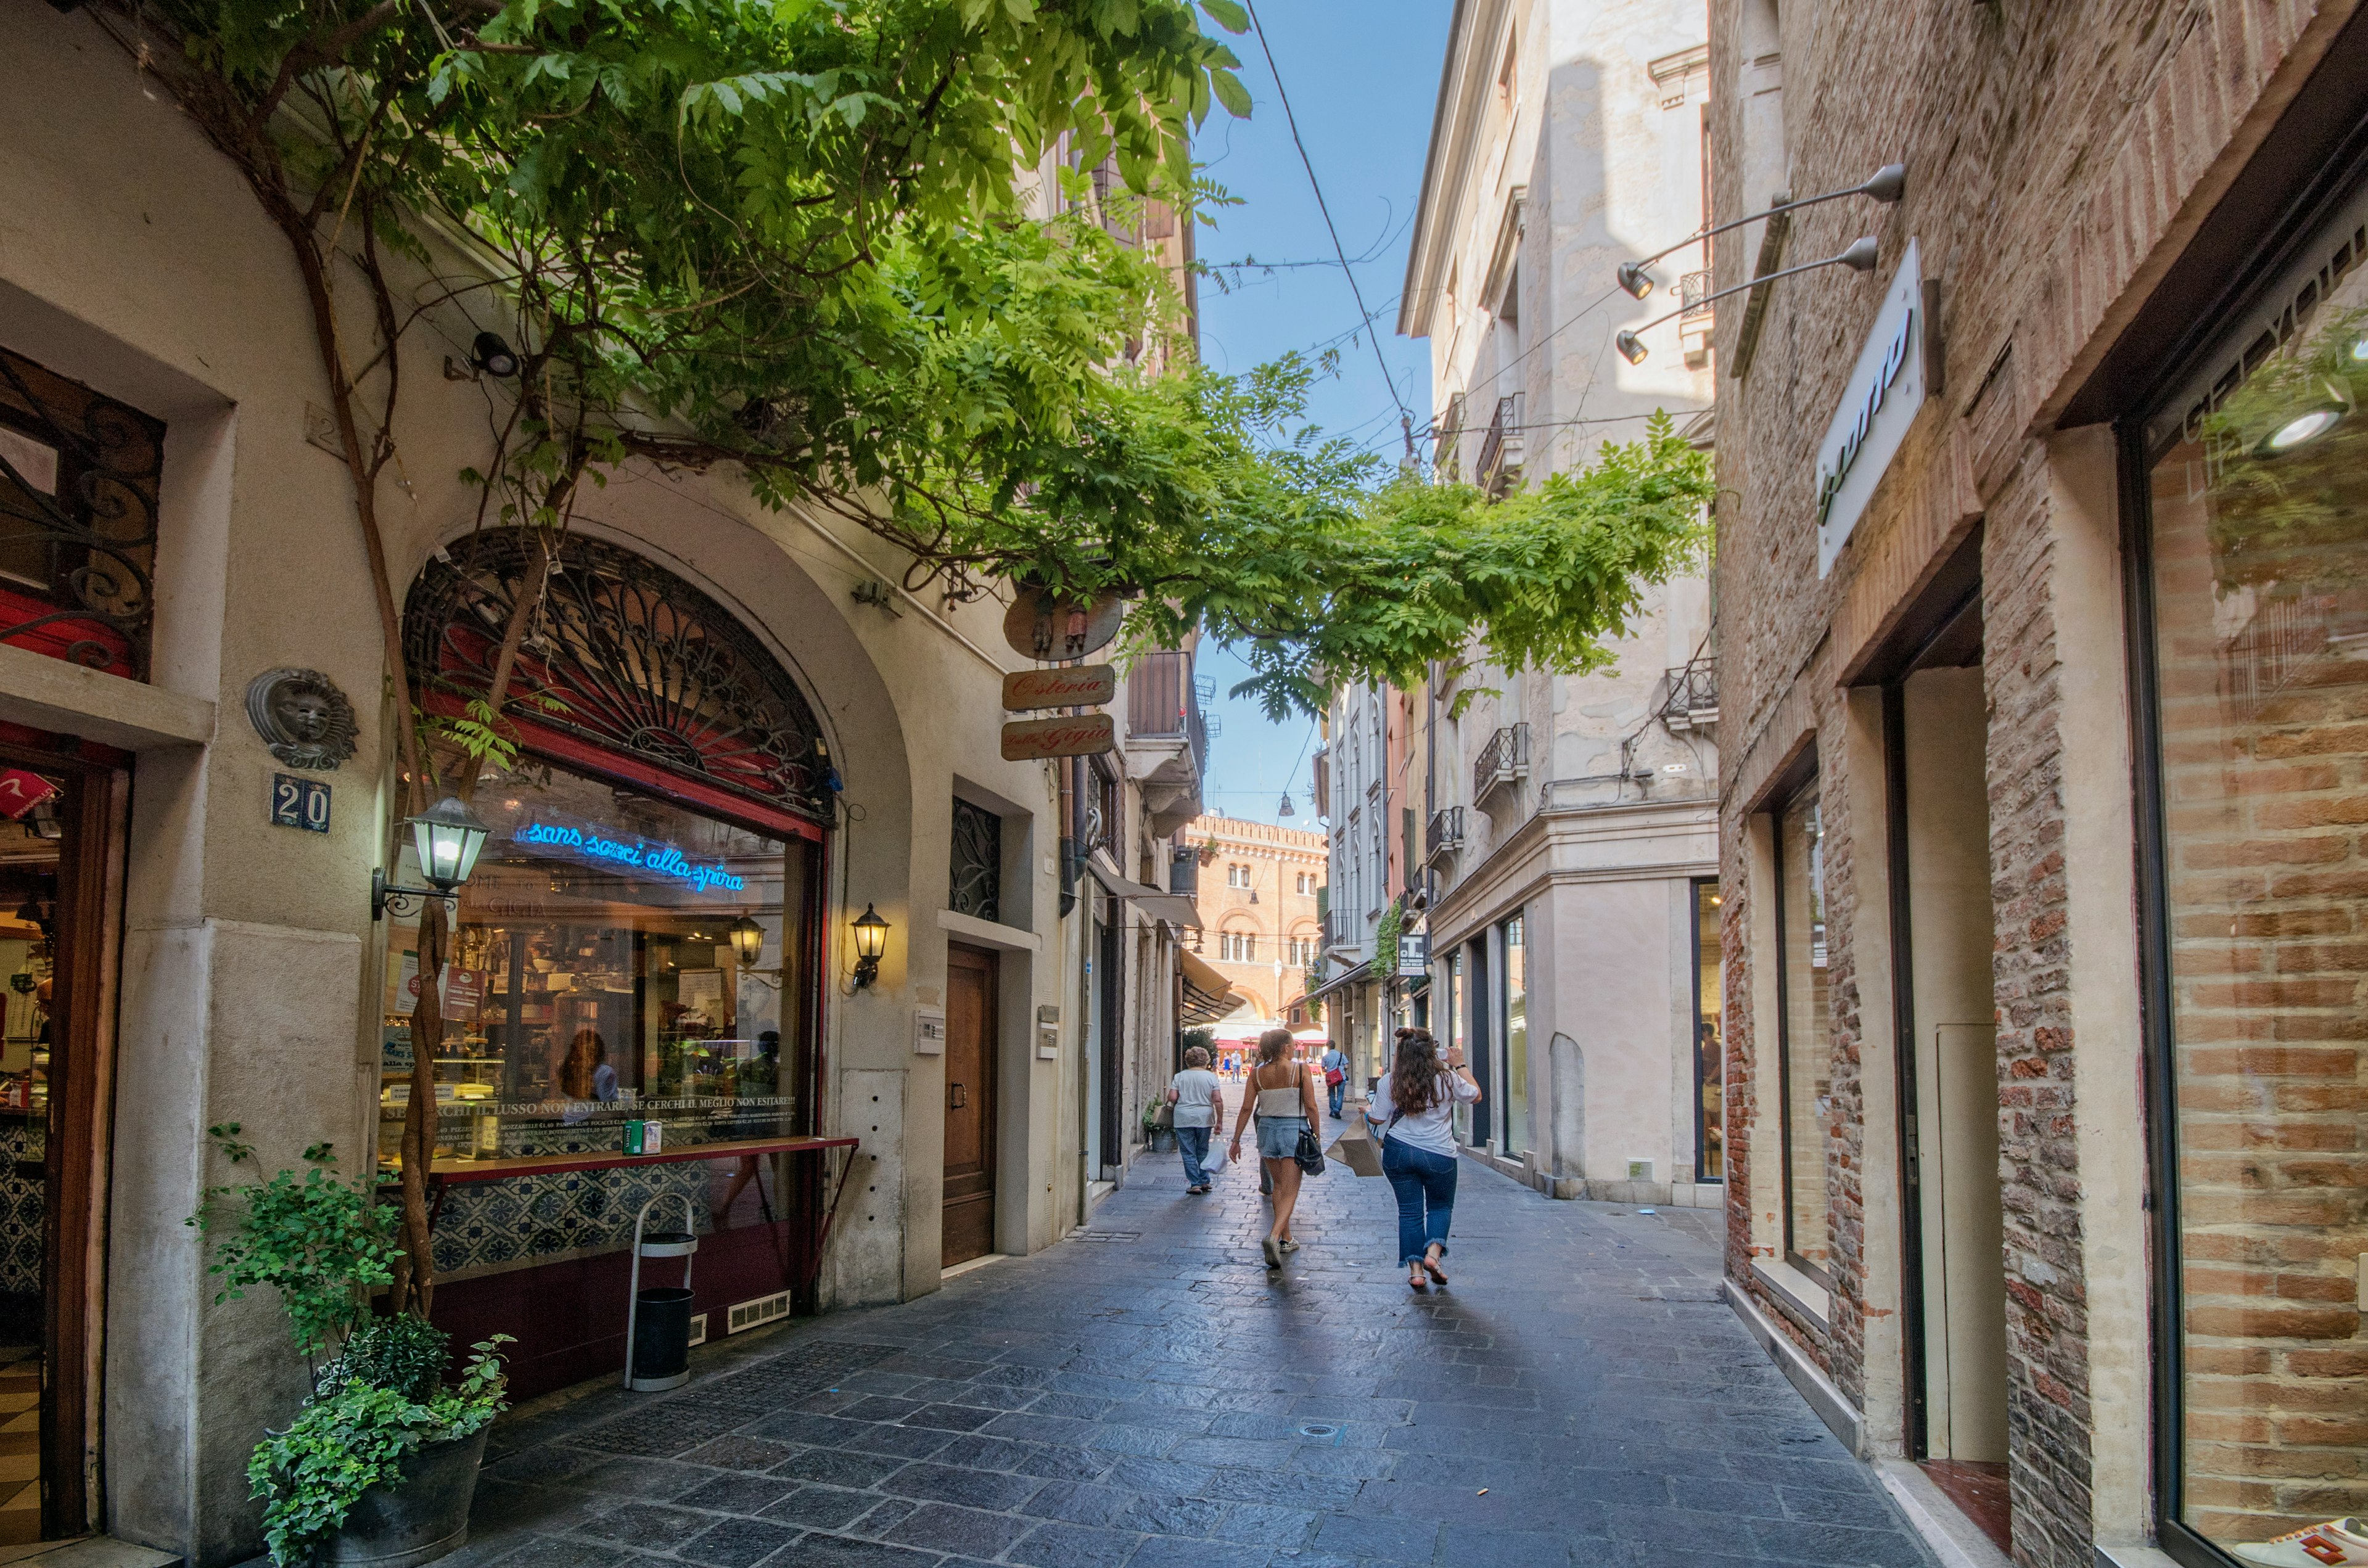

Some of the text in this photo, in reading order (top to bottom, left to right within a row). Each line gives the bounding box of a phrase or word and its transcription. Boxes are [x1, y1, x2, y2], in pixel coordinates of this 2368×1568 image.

[1013, 675, 1101, 697] Osteria
[1039, 724, 1111, 750] Gigia
[278, 783, 328, 825] 20
[527, 823, 744, 892] sans souci alla spina
[1402, 937, 1423, 958] T
[386, 1106, 406, 1119] SE
[435, 1104, 472, 1117] RCHI
[475, 1103, 490, 1115] IL
[495, 1102, 536, 1115] LUSSO
[541, 1101, 570, 1114] NON
[632, 1100, 644, 1111] SE
[648, 1099, 685, 1110] CERCHI
[688, 1099, 697, 1109] IL
[699, 1098, 734, 1109] MEGLIO
[737, 1097, 756, 1107] NON
[757, 1096, 796, 1106] ESITARE!!!
